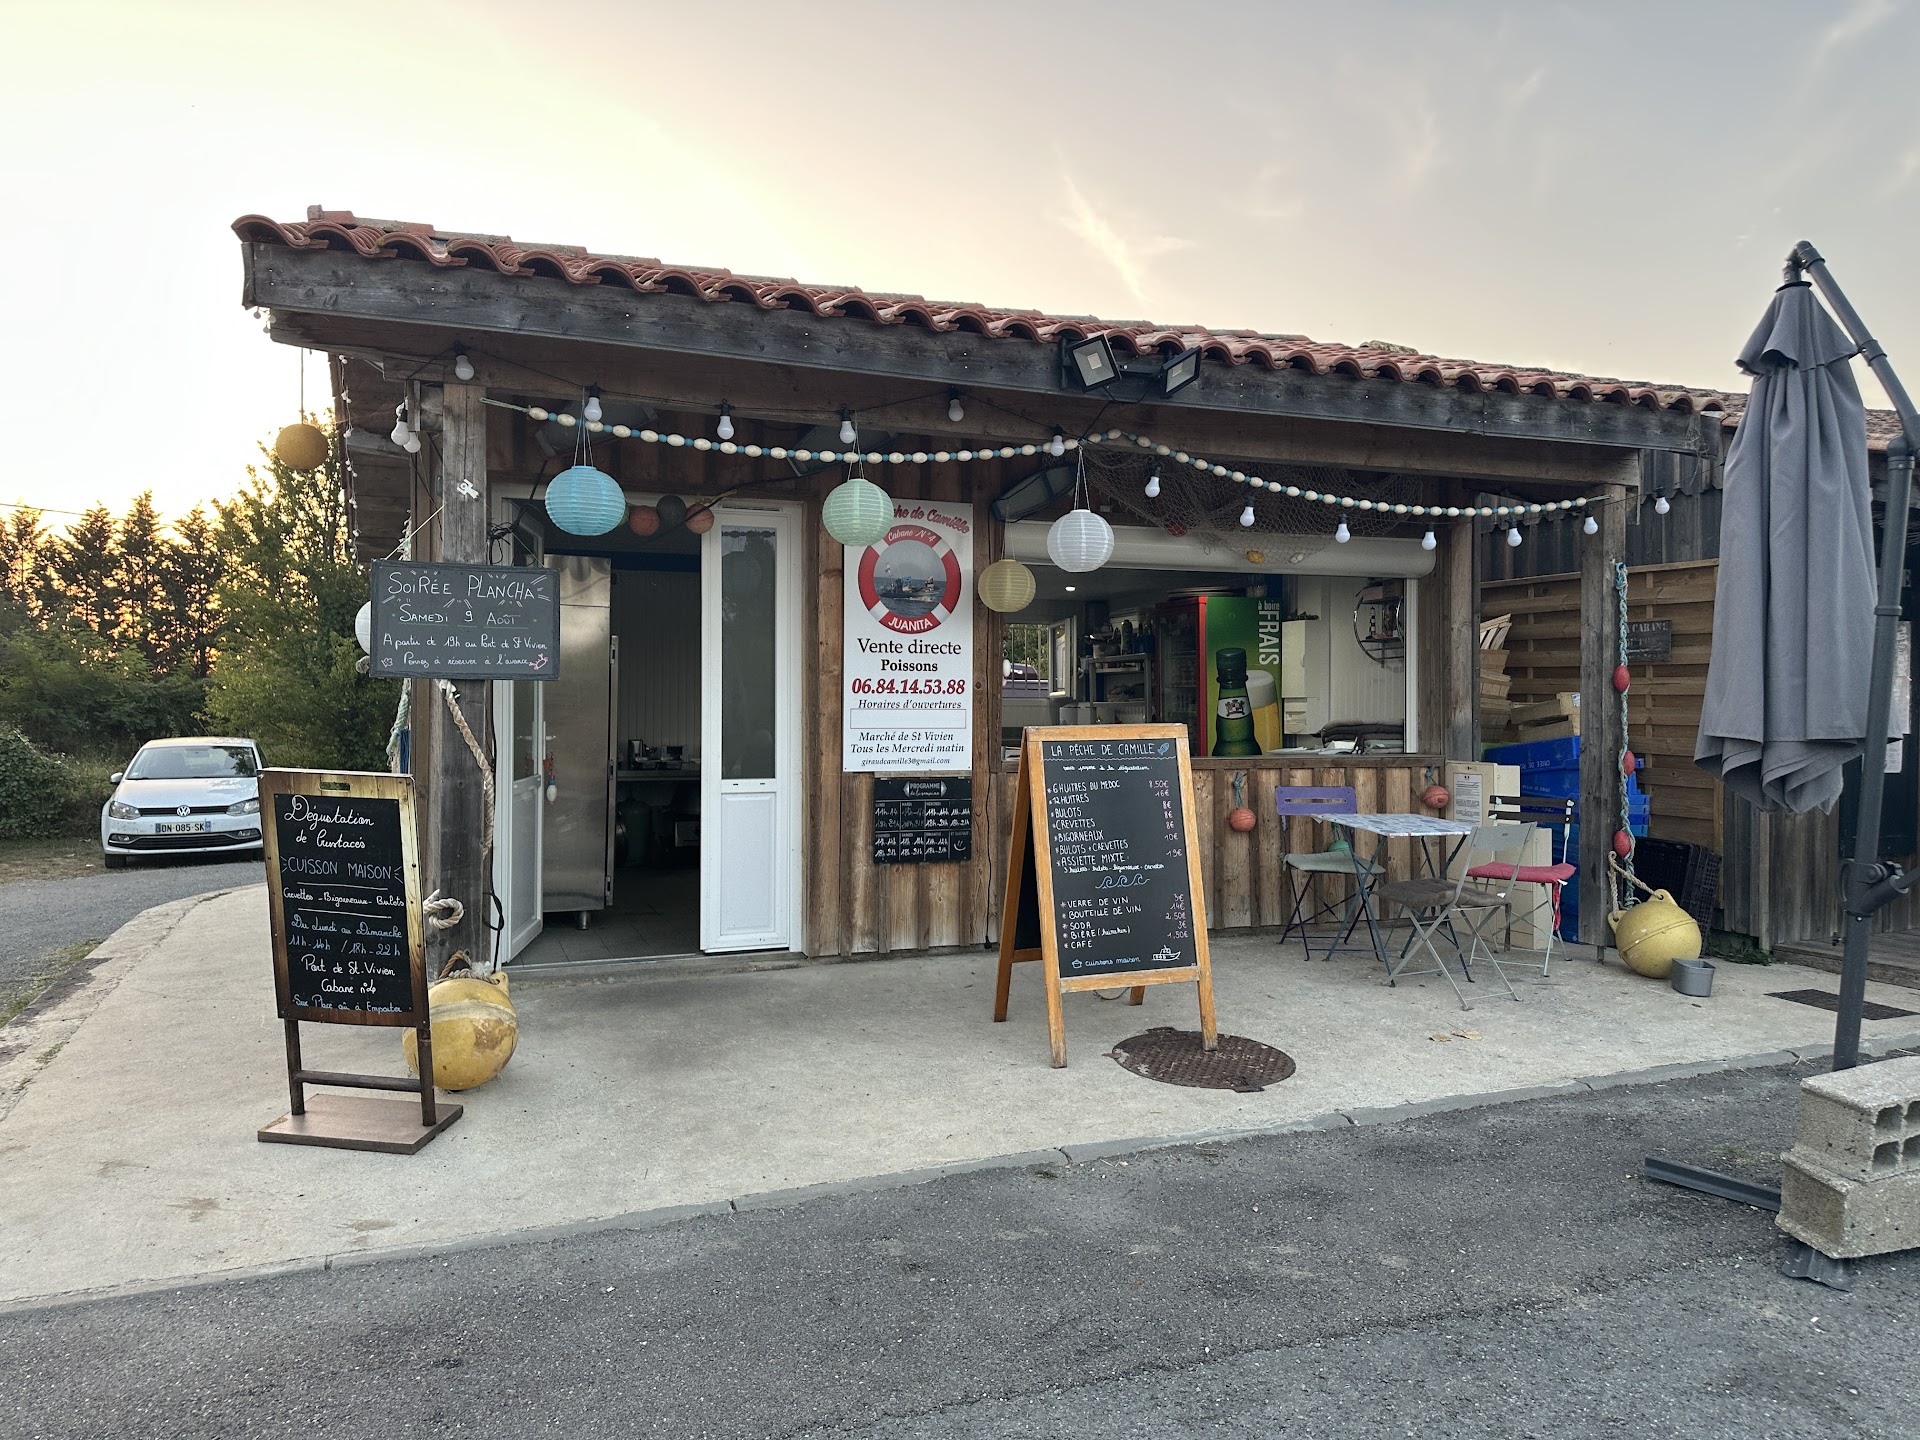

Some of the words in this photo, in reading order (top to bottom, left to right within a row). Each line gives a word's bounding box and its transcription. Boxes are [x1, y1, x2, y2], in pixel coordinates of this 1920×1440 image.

[910, 506, 925, 520] de
[927, 509, 970, 534] Camille
[888, 530, 913, 541] Cabane
[467, 574, 535, 600] PLANCHA
[1264, 600, 1280, 610] boire
[464, 610, 473, 622] 9
[888, 617, 933, 631] JUANITA
[426, 636, 436, 645] de
[443, 636, 461, 647] 19h
[465, 639, 477, 648] au
[481, 633, 496, 648] Port
[501, 637, 510, 649] de
[513, 636, 522, 649] St
[524, 637, 548, 650] Vivien
[1259, 610, 1280, 665] FRAIS
[857, 638, 903, 654] Vente
[908, 639, 961, 655] directe
[403, 651, 429, 668] Pensez
[434, 656, 441, 664] à
[447, 656, 477, 665] réserver
[484, 655, 491, 665] à
[881, 659, 938, 672] Poissons
[851, 678, 966, 694] 06.84.14.53.88
[858, 700, 900, 708] Horaires
[903, 700, 961, 709] d'ouvertures
[859, 731, 896, 741] Marché
[898, 731, 908, 741] de
[911, 731, 921, 741] St
[925, 731, 954, 741] Vivien
[851, 744, 873, 753] Tous
[876, 744, 889, 753] les
[892, 743, 934, 753] Mercredi
[936, 743, 964, 752] matin
[1051, 745, 1063, 756] LA
[1069, 743, 1095, 756] PÊCHE
[1101, 744, 1113, 755] DE
[1118, 743, 1156, 755] CAMILLE
[284, 795, 374, 830] Dégustation
[1055, 806, 1082, 818] BULOTS
[1055, 818, 1096, 831] CREVETTES
[296, 829, 307, 843] de
[1058, 829, 1104, 842] BIGORNEAUX
[1060, 844, 1086, 855] BULOTS
[1092, 839, 1129, 851] CREVETTES
[1061, 855, 1096, 866] ASSIETTE
[1101, 852, 1125, 864] MIXTE
[283, 887, 314, 900] Crevettes
[376, 895, 404, 906] Bulots
[1067, 899, 1092, 908] VERRE
[1098, 898, 1109, 906] DE
[1112, 896, 1129, 905] VIN
[1069, 907, 1109, 920] BOUTEILLE
[1112, 906, 1122, 916] DE
[1126, 904, 1142, 914] VIN
[291, 914, 309, 929] Du
[312, 916, 337, 932] Lundi
[356, 921, 402, 938] Dimanche
[1070, 921, 1091, 930] SODA
[300, 954, 326, 972] Port
[333, 962, 343, 974] de
[321, 978, 354, 993] Cabane
[312, 994, 333, 1009] Place
[355, 1002, 361, 1011] à
[366, 1001, 402, 1014] Emporter
